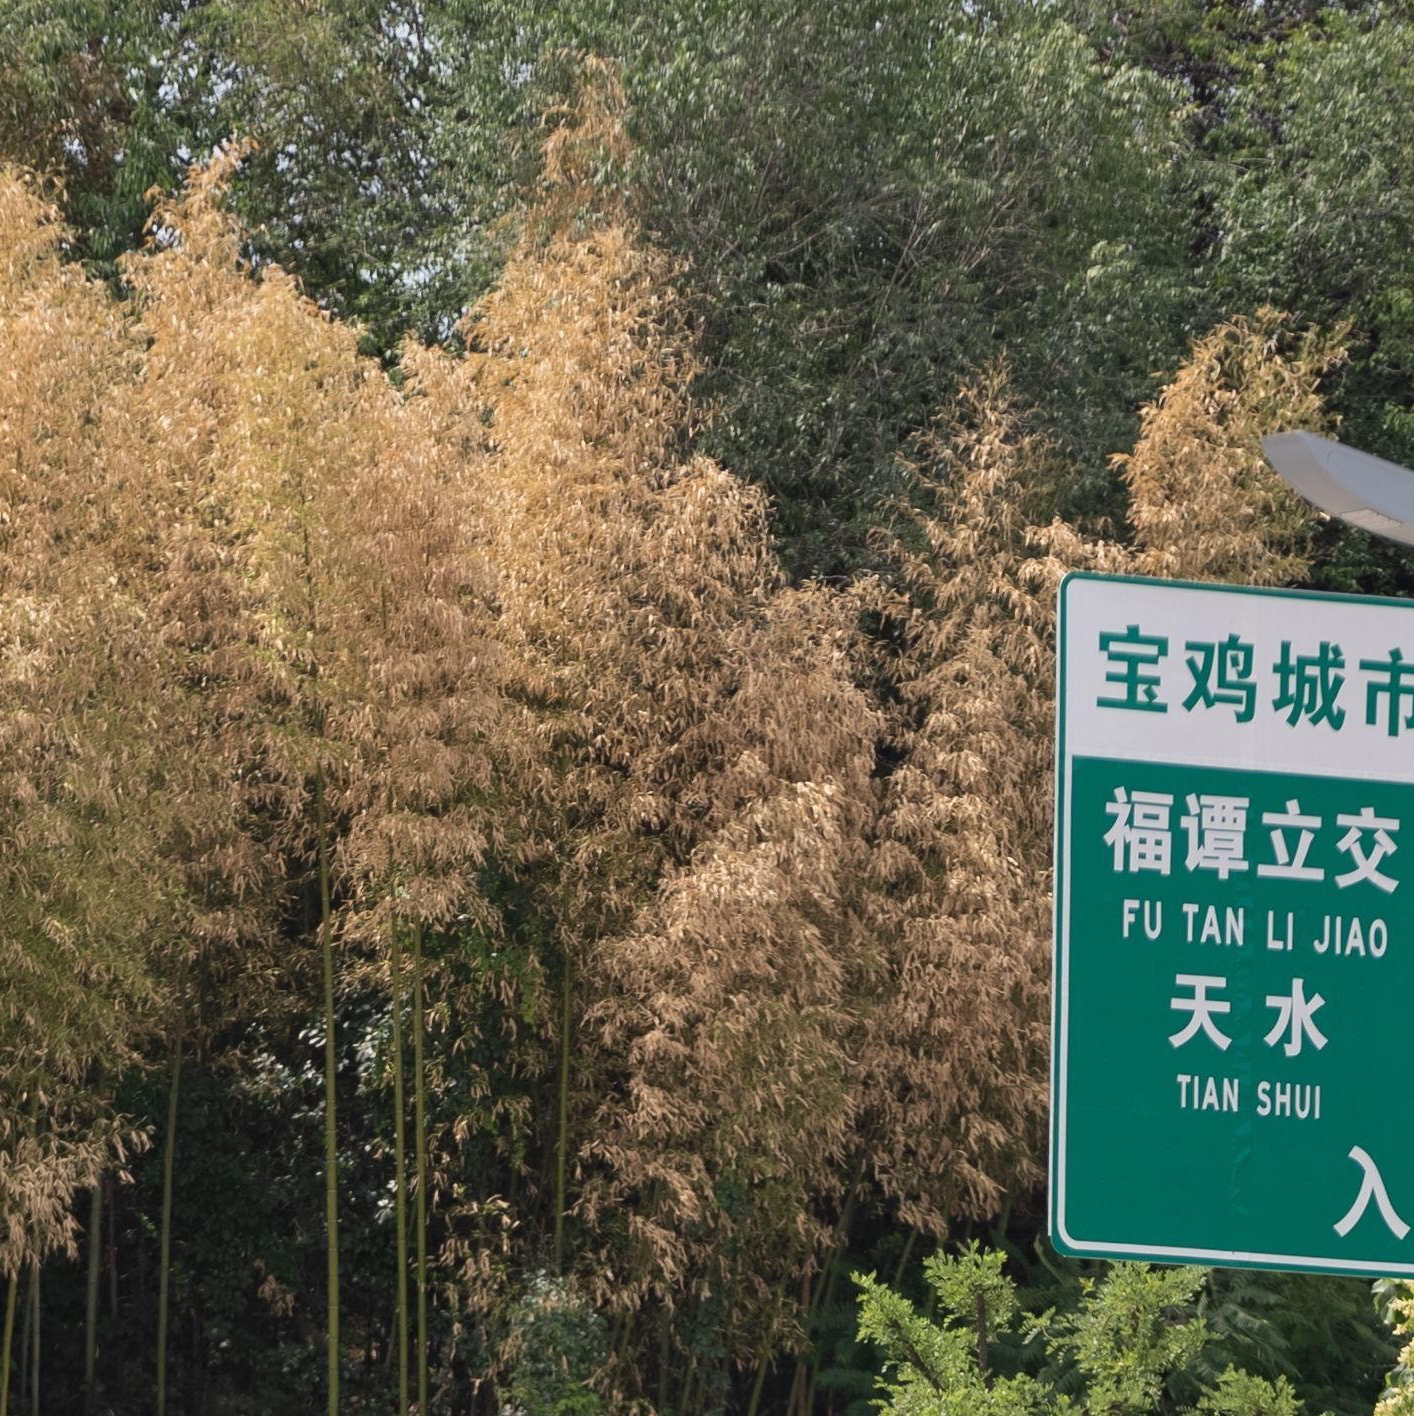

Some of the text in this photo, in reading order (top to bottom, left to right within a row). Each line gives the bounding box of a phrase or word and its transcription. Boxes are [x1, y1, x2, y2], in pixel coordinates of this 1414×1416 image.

[1104, 787, 1399, 892] 福谭立交
[1124, 900, 1387, 957] FU TAN LI JIAO
[1169, 975, 1328, 1056] 天水
[1177, 1075, 1319, 1118] TIAN SHUI
